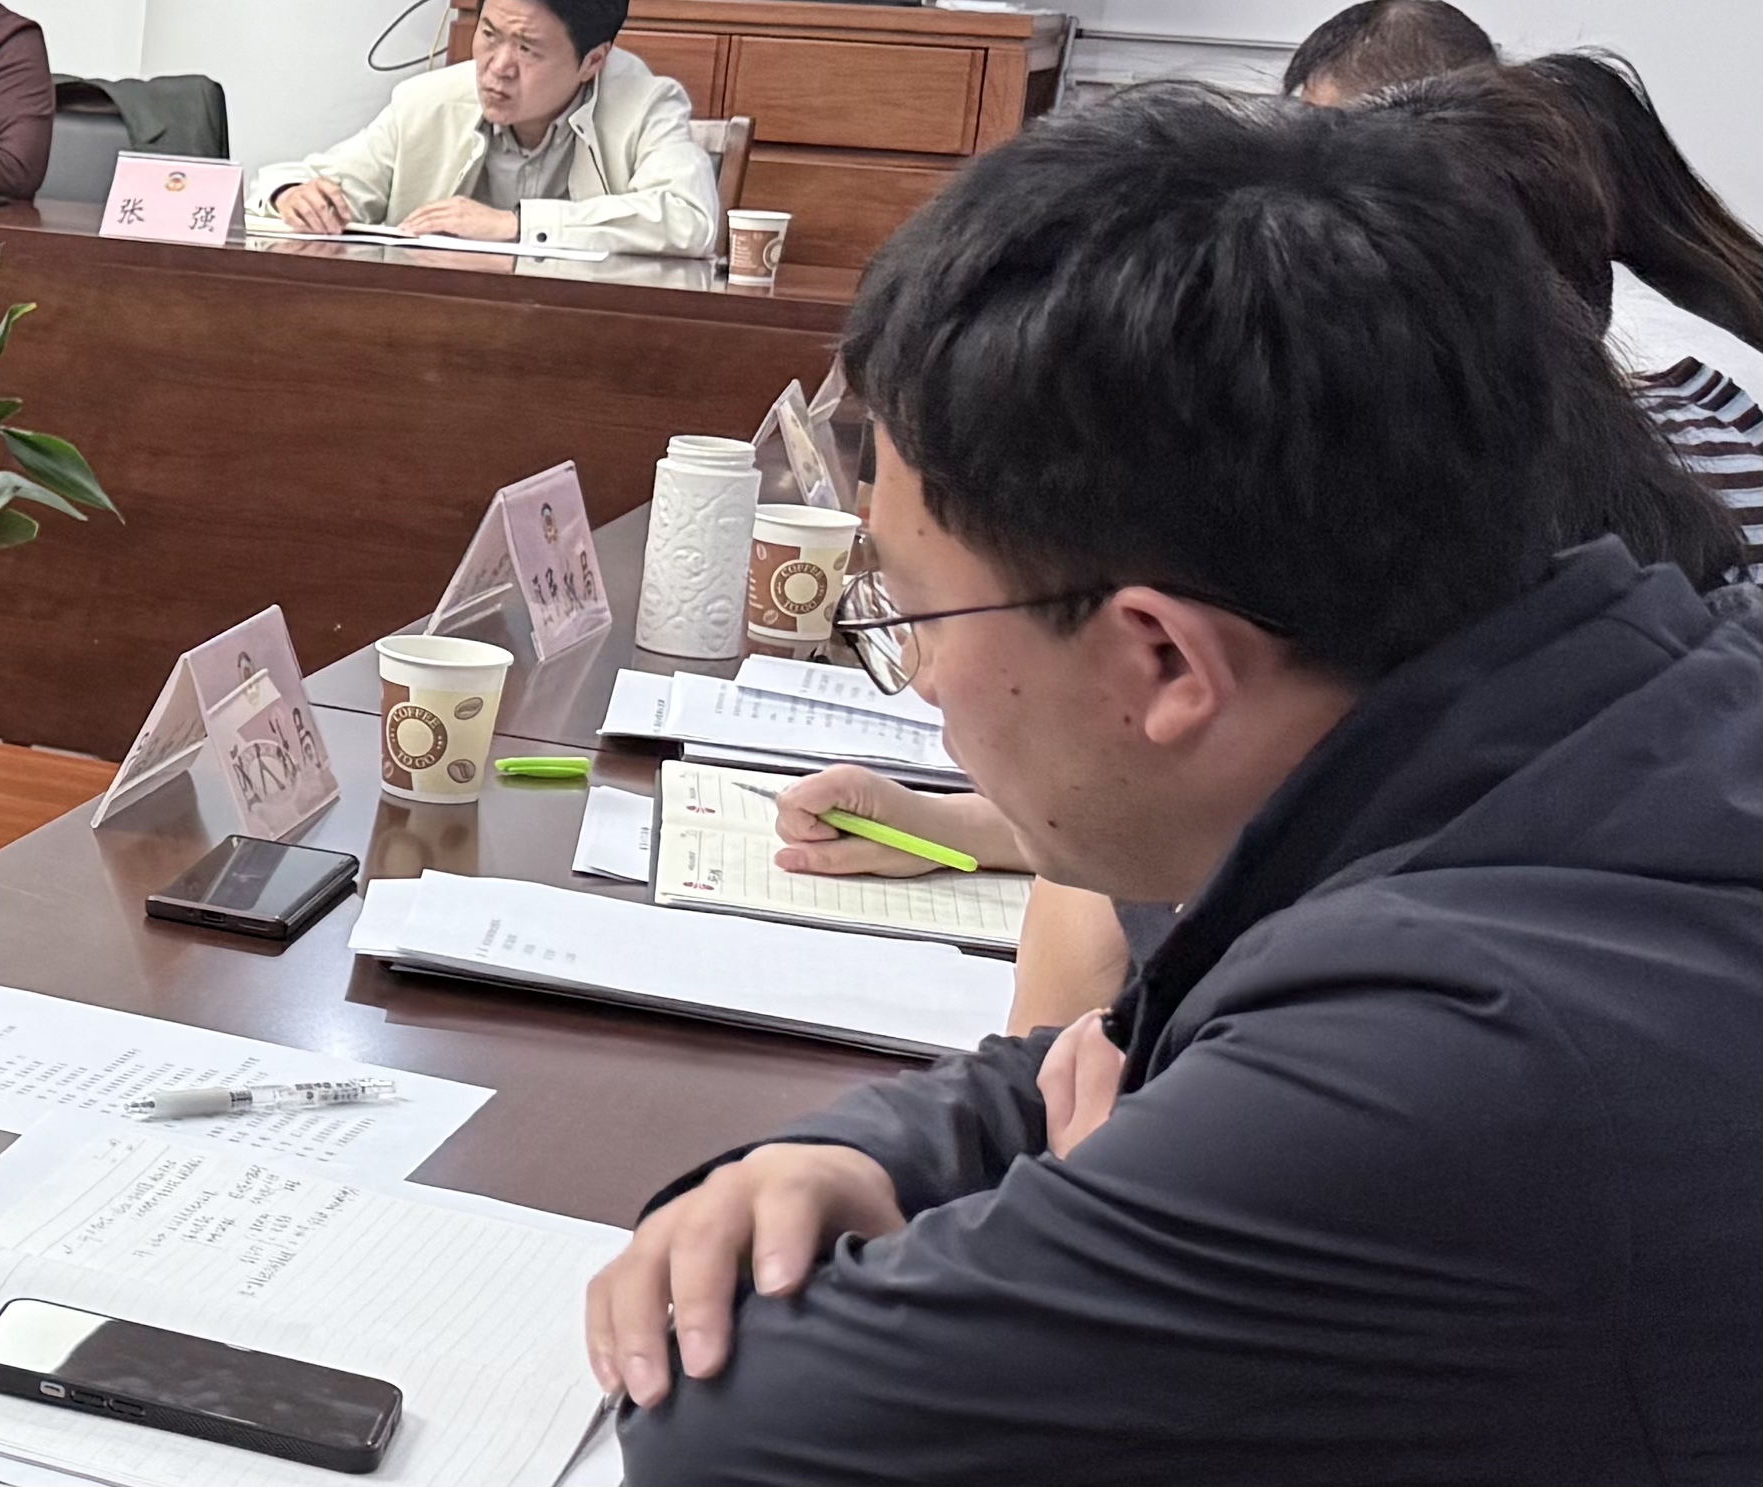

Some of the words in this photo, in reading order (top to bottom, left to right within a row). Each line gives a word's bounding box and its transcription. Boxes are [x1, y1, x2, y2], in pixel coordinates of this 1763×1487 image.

[116, 197, 217, 233] 张强
[392, 707, 440, 729] COFFEE
[397, 750, 413, 766] TO
[415, 754, 436, 768] GO
